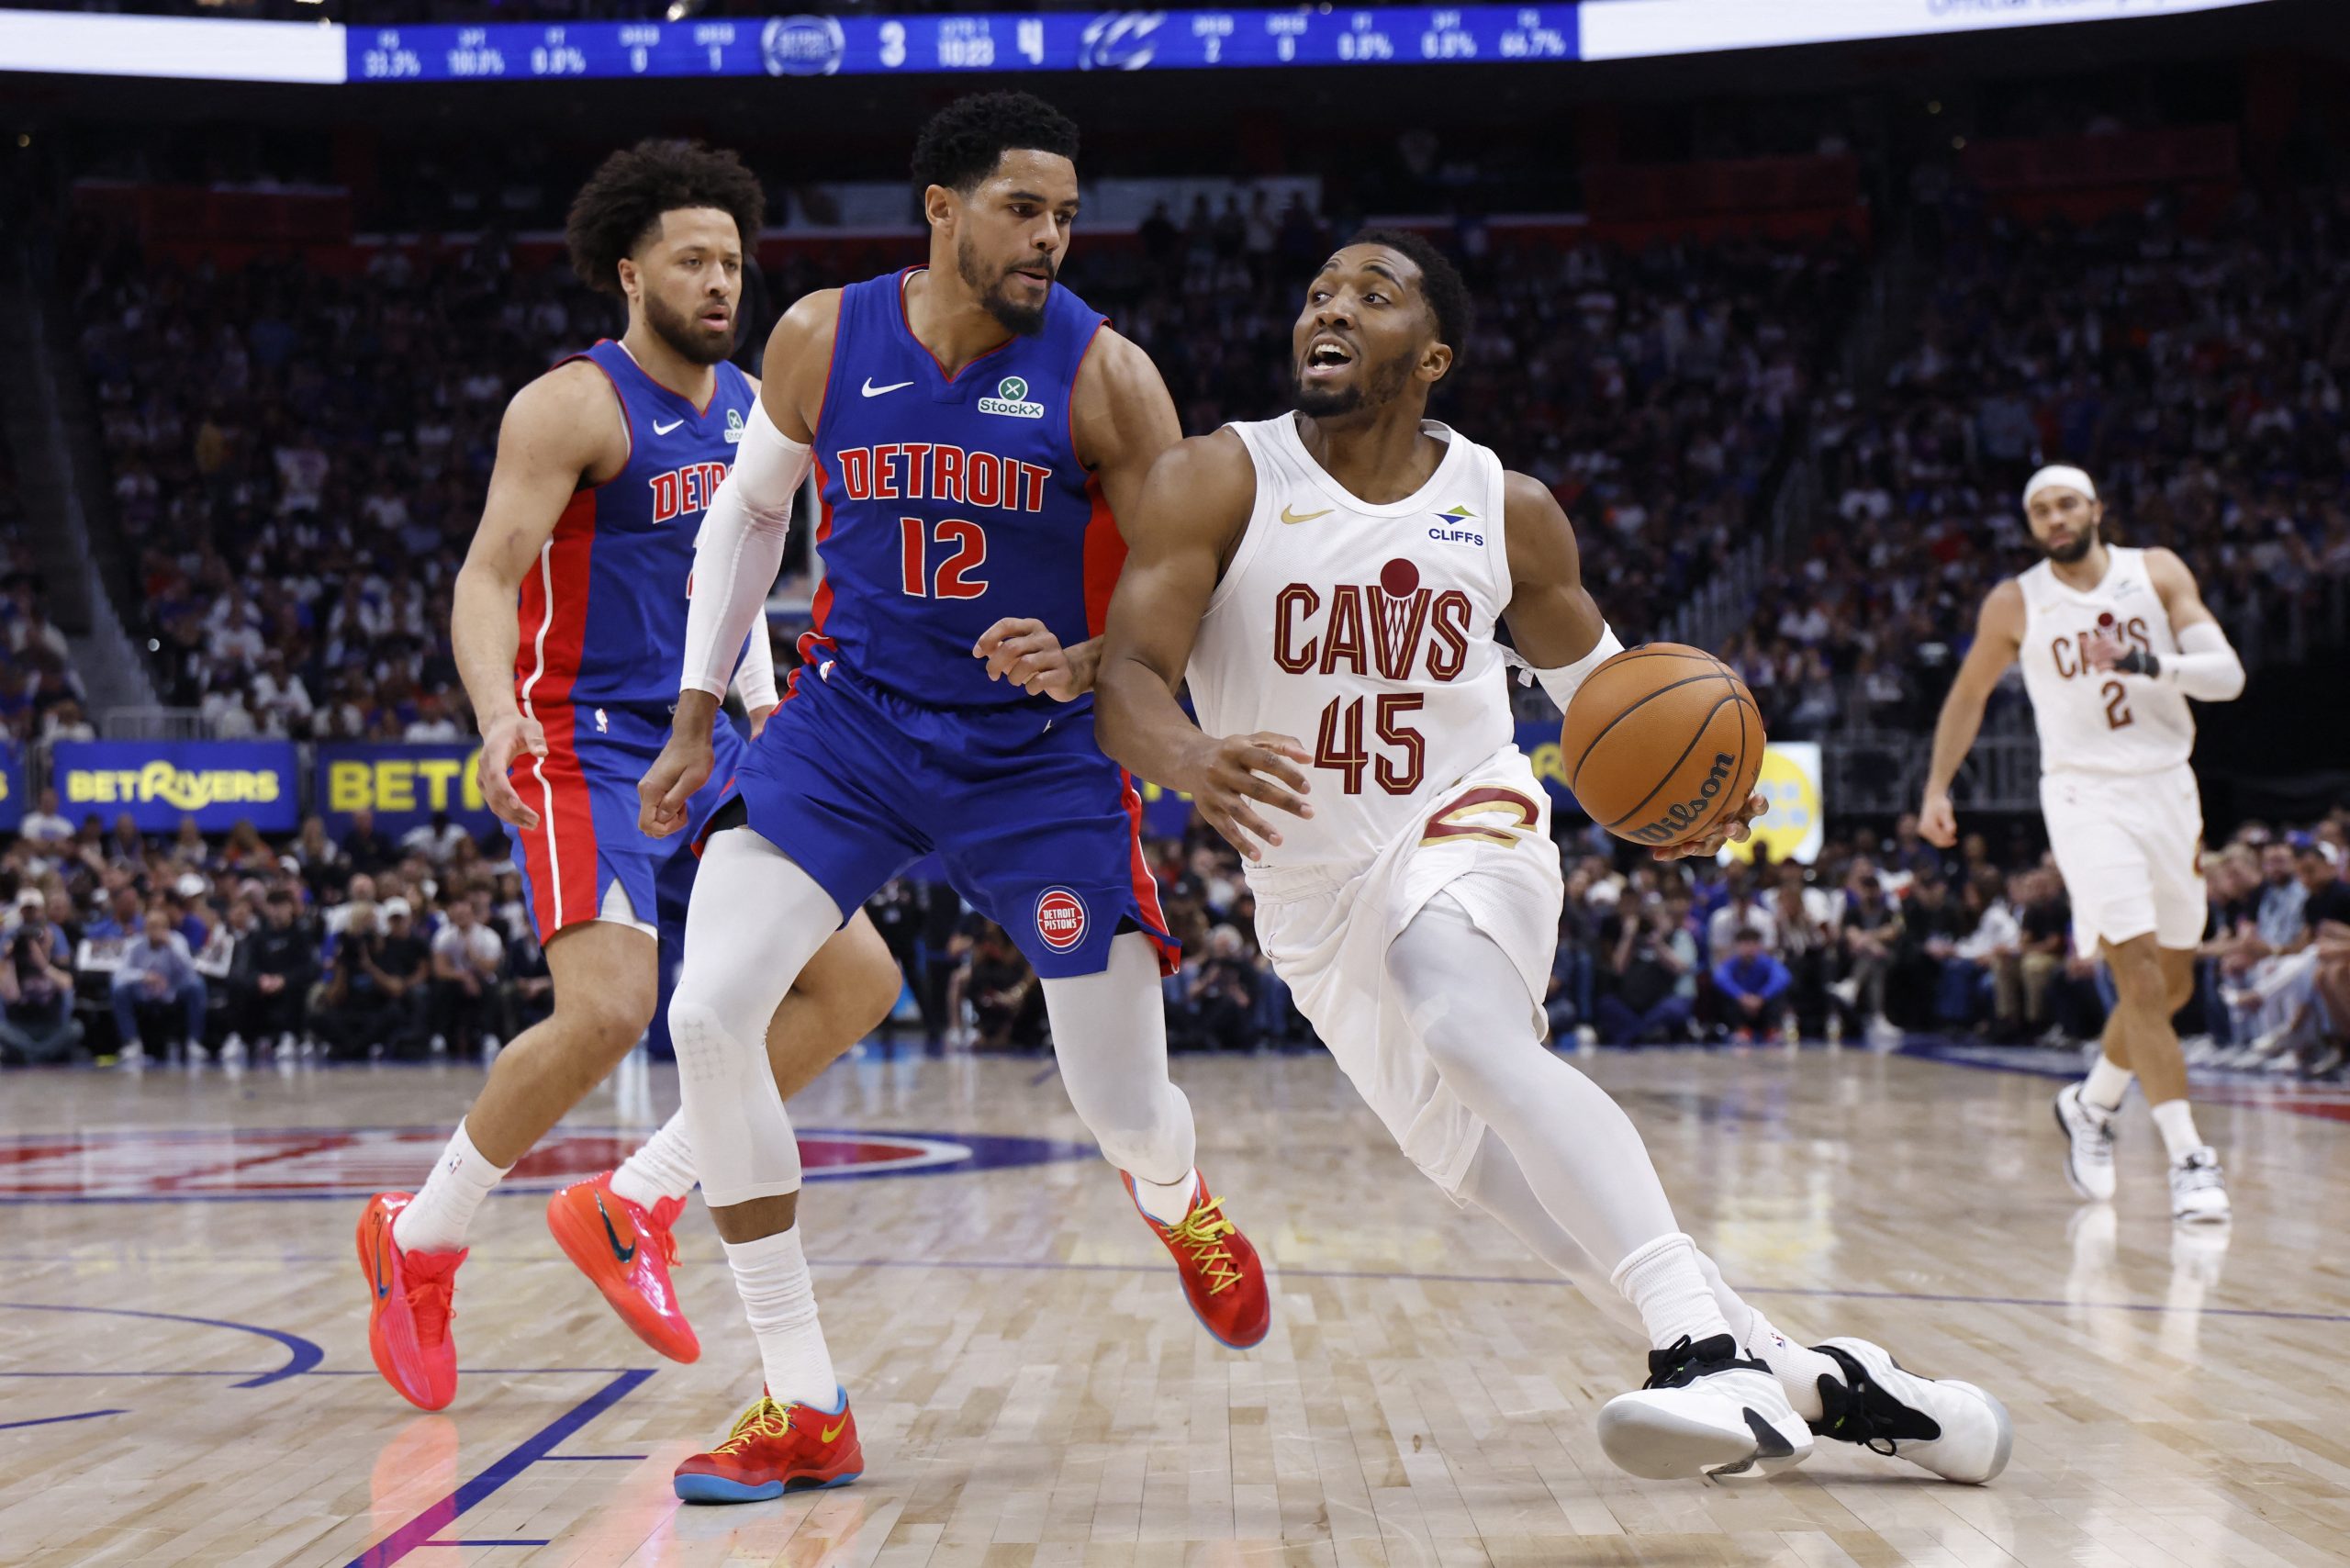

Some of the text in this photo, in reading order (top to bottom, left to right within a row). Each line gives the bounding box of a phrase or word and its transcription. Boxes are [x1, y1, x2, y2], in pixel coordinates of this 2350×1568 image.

[878, 20, 906, 67] 3
[1017, 18, 1043, 65] 4
[979, 399, 1041, 416] StockX
[837, 442, 1052, 512] DETROIT
[900, 517, 989, 599] 12
[1428, 528, 1484, 546] CLIFFS
[1273, 582, 1472, 681] CAVS
[2100, 680, 2133, 731] 2
[1314, 692, 1426, 795] 45
[1627, 752, 1736, 844] Wilson
[1043, 908, 1076, 920] DETROIT
[1044, 918, 1078, 930] PISTONS
